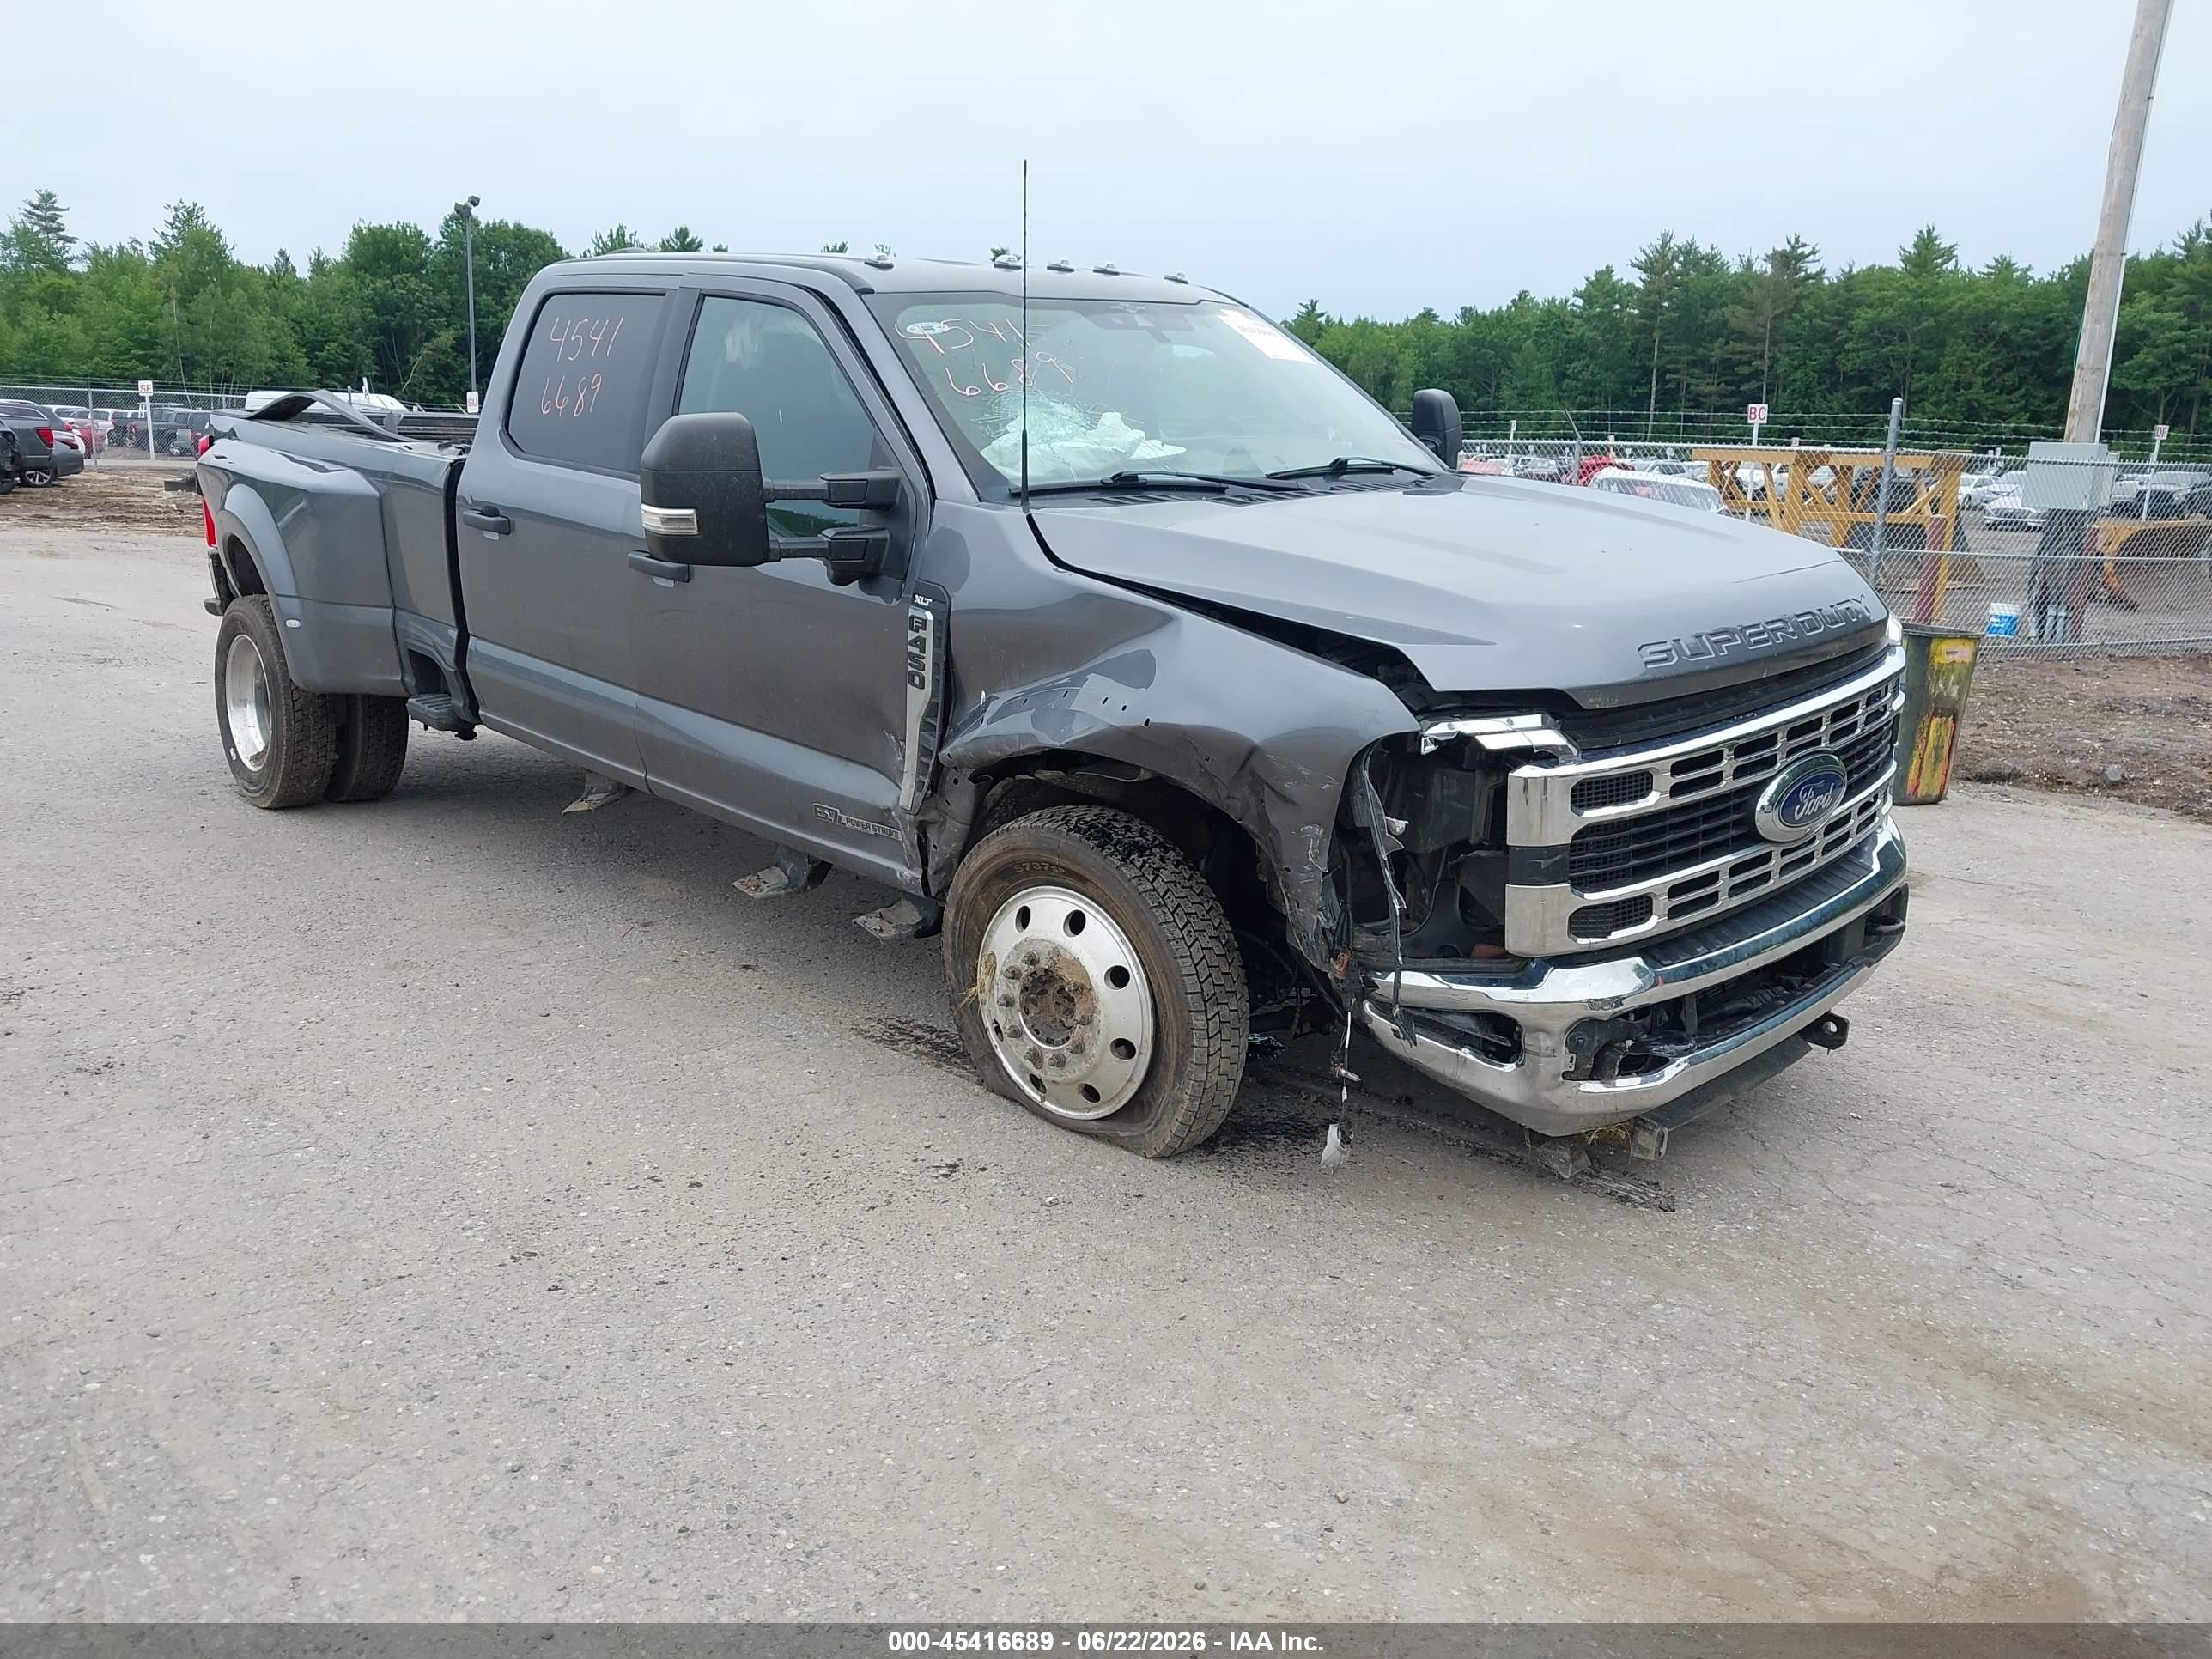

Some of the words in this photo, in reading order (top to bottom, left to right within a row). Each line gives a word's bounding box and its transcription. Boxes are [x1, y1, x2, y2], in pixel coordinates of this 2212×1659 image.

[550, 316, 624, 362] 4541
[894, 318, 1031, 356] 4541
[945, 351, 1073, 397] 6689
[541, 373, 603, 417] 6689
[1749, 406, 1767, 421] BC
[2156, 426, 2168, 438] DF
[914, 593, 933, 606] XLT
[1636, 618, 1798, 668] SUPER
[1796, 593, 1872, 635] DUTY
[1793, 777, 1836, 821] Ford
[846, 817, 872, 831] POWER
[871, 824, 900, 838] STROKE
